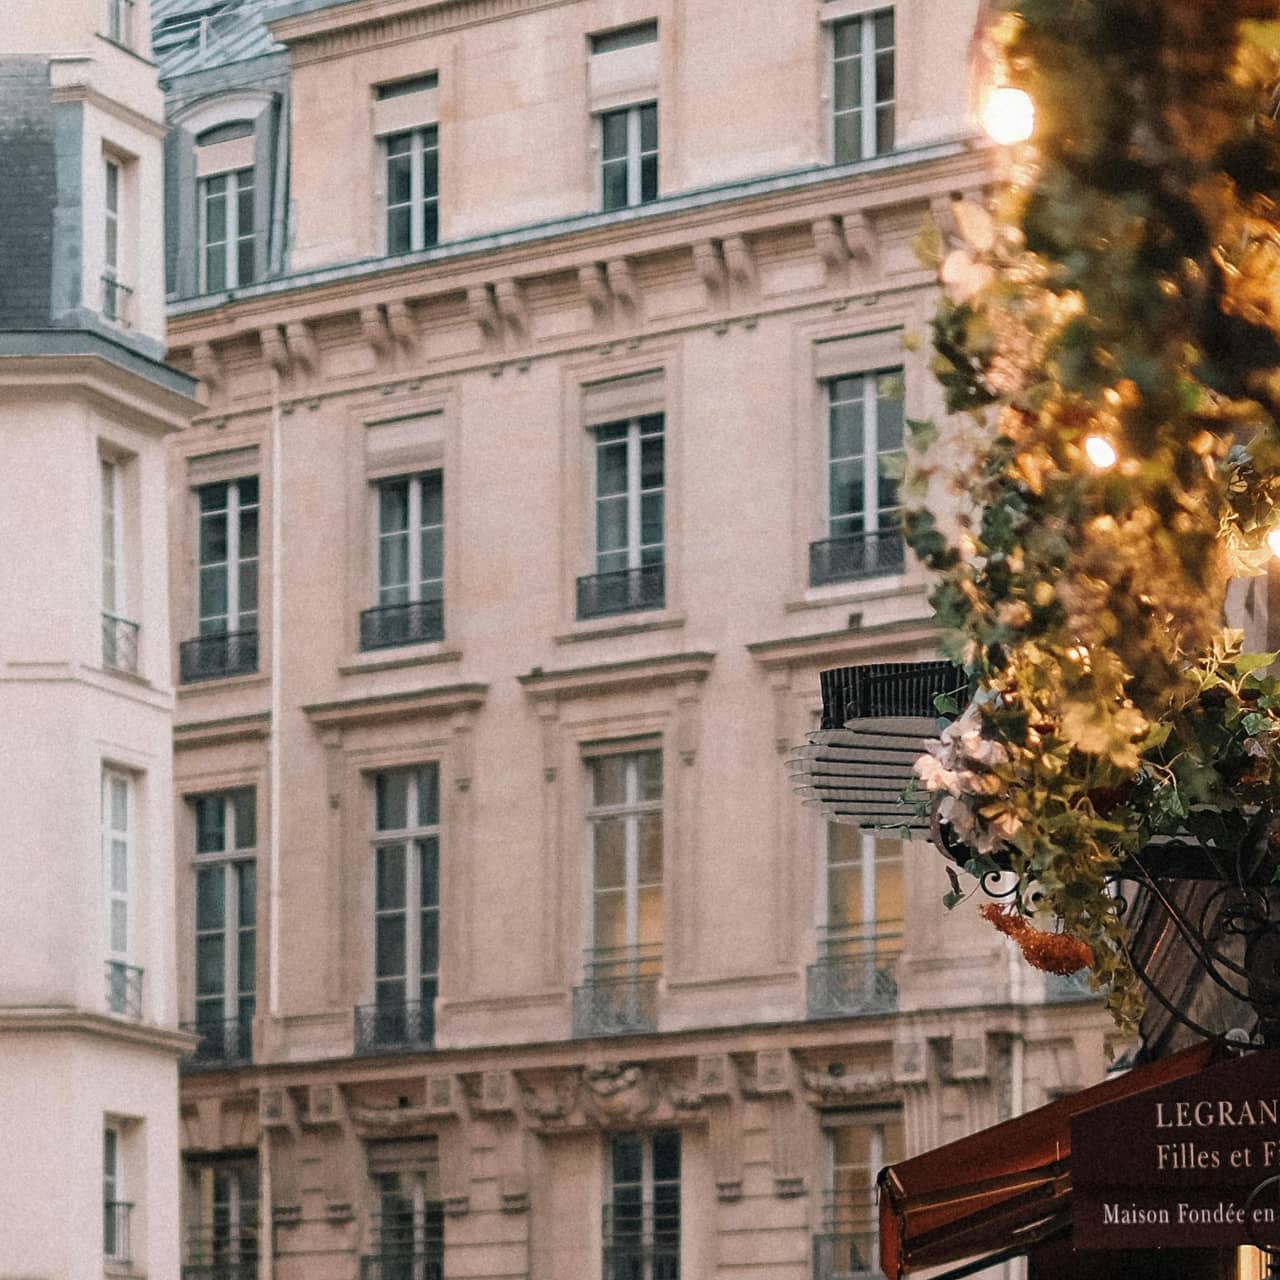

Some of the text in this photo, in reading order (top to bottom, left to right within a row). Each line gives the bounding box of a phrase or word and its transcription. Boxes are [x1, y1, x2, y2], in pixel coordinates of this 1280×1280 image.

[1157, 1142, 1220, 1170] Filles
[1230, 1147, 1252, 1168] et
[1103, 1203, 1169, 1225] Maison
[1178, 1202, 1245, 1224] Fondée
[1253, 1208, 1274, 1222] en
